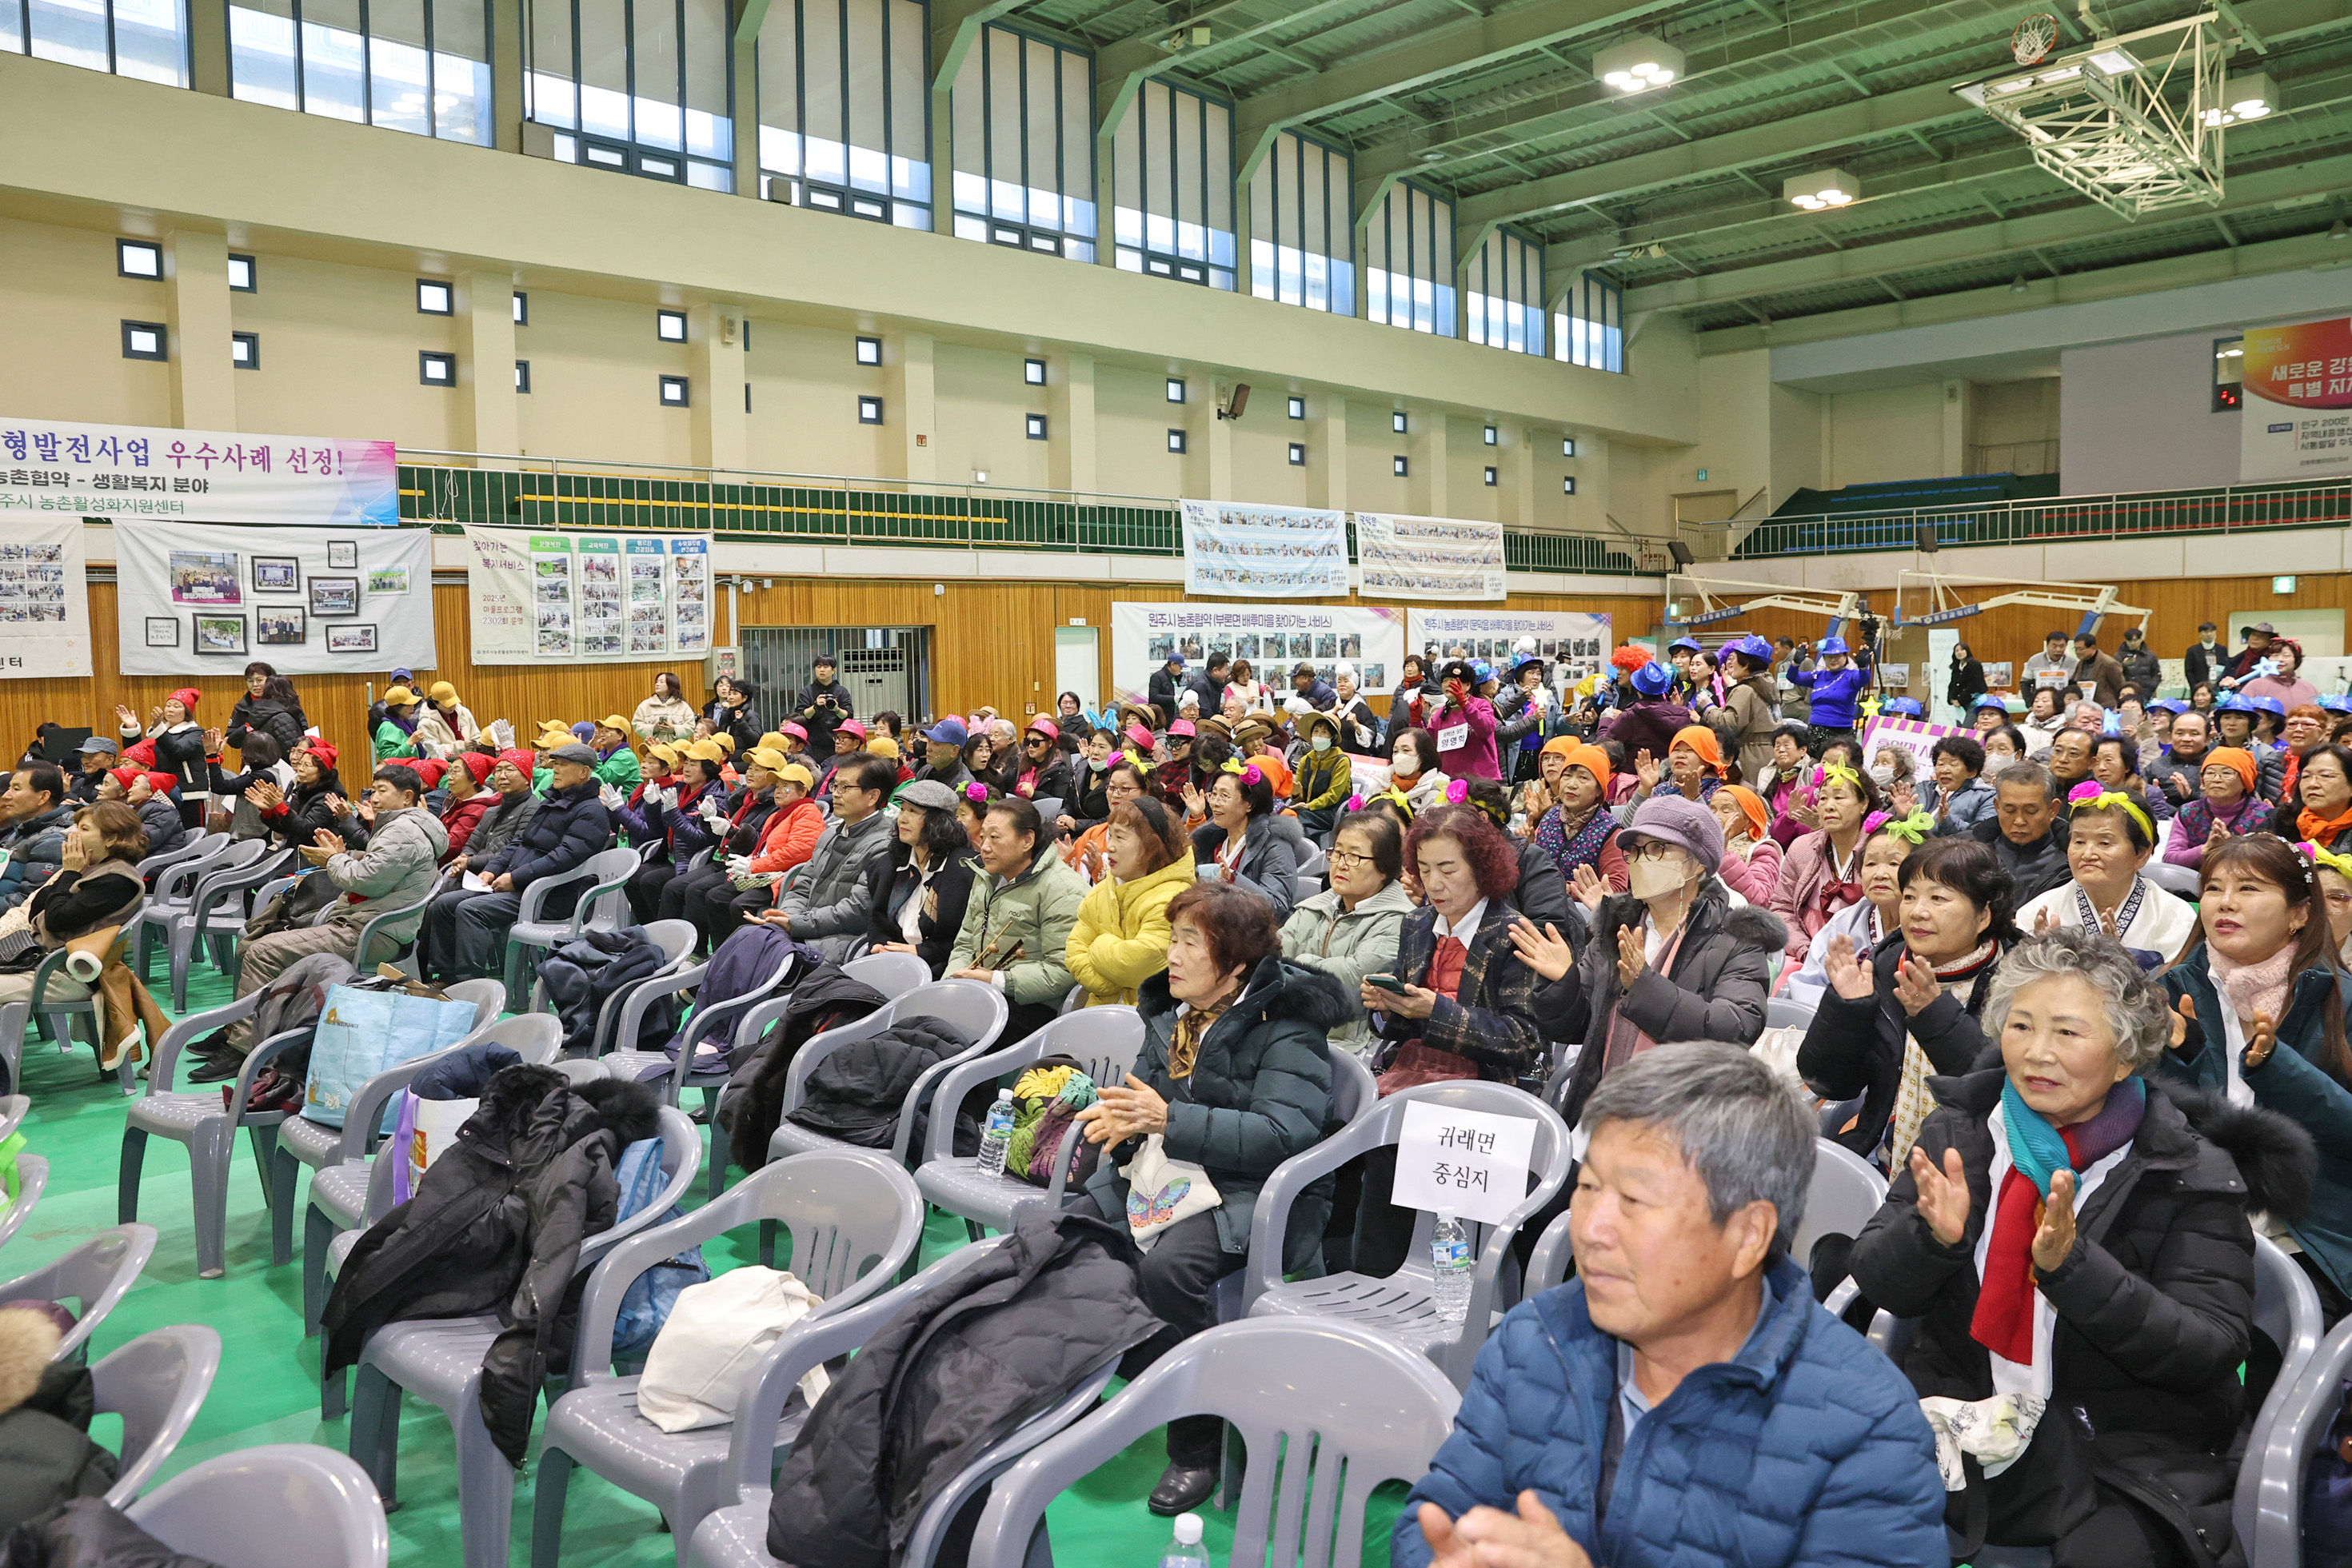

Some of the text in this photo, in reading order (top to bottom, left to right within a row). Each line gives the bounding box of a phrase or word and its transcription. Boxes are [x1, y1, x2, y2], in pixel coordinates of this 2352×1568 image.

[2271, 357, 2352, 381] 새로운 강
[2288, 381, 2322, 398] 특별
[2302, 420, 2318, 429] 인구
[166, 441, 270, 473] 우수사례
[286, 447, 344, 476] 선정!
[92, 473, 166, 492] 생활복지
[173, 477, 209, 493] 분야
[38, 494, 185, 515] 농촌활성화지원센터
[473, 540, 508, 553] 찾아가는
[482, 558, 525, 571] 복지서비스
[483, 605, 523, 614] 마을프로그램
[511, 616, 524, 625] 운영
[1148, 613, 1332, 628] 원주시 농촌협약 (부론면 배후마을 찾아가는 서비스)
[1424, 618, 1554, 631] 원주시 농촌협약 (문막읍 배후마을 찾아가는 서비스)
[1437, 1126, 1495, 1155] 귀래면
[1432, 1162, 1488, 1193] 중심지
